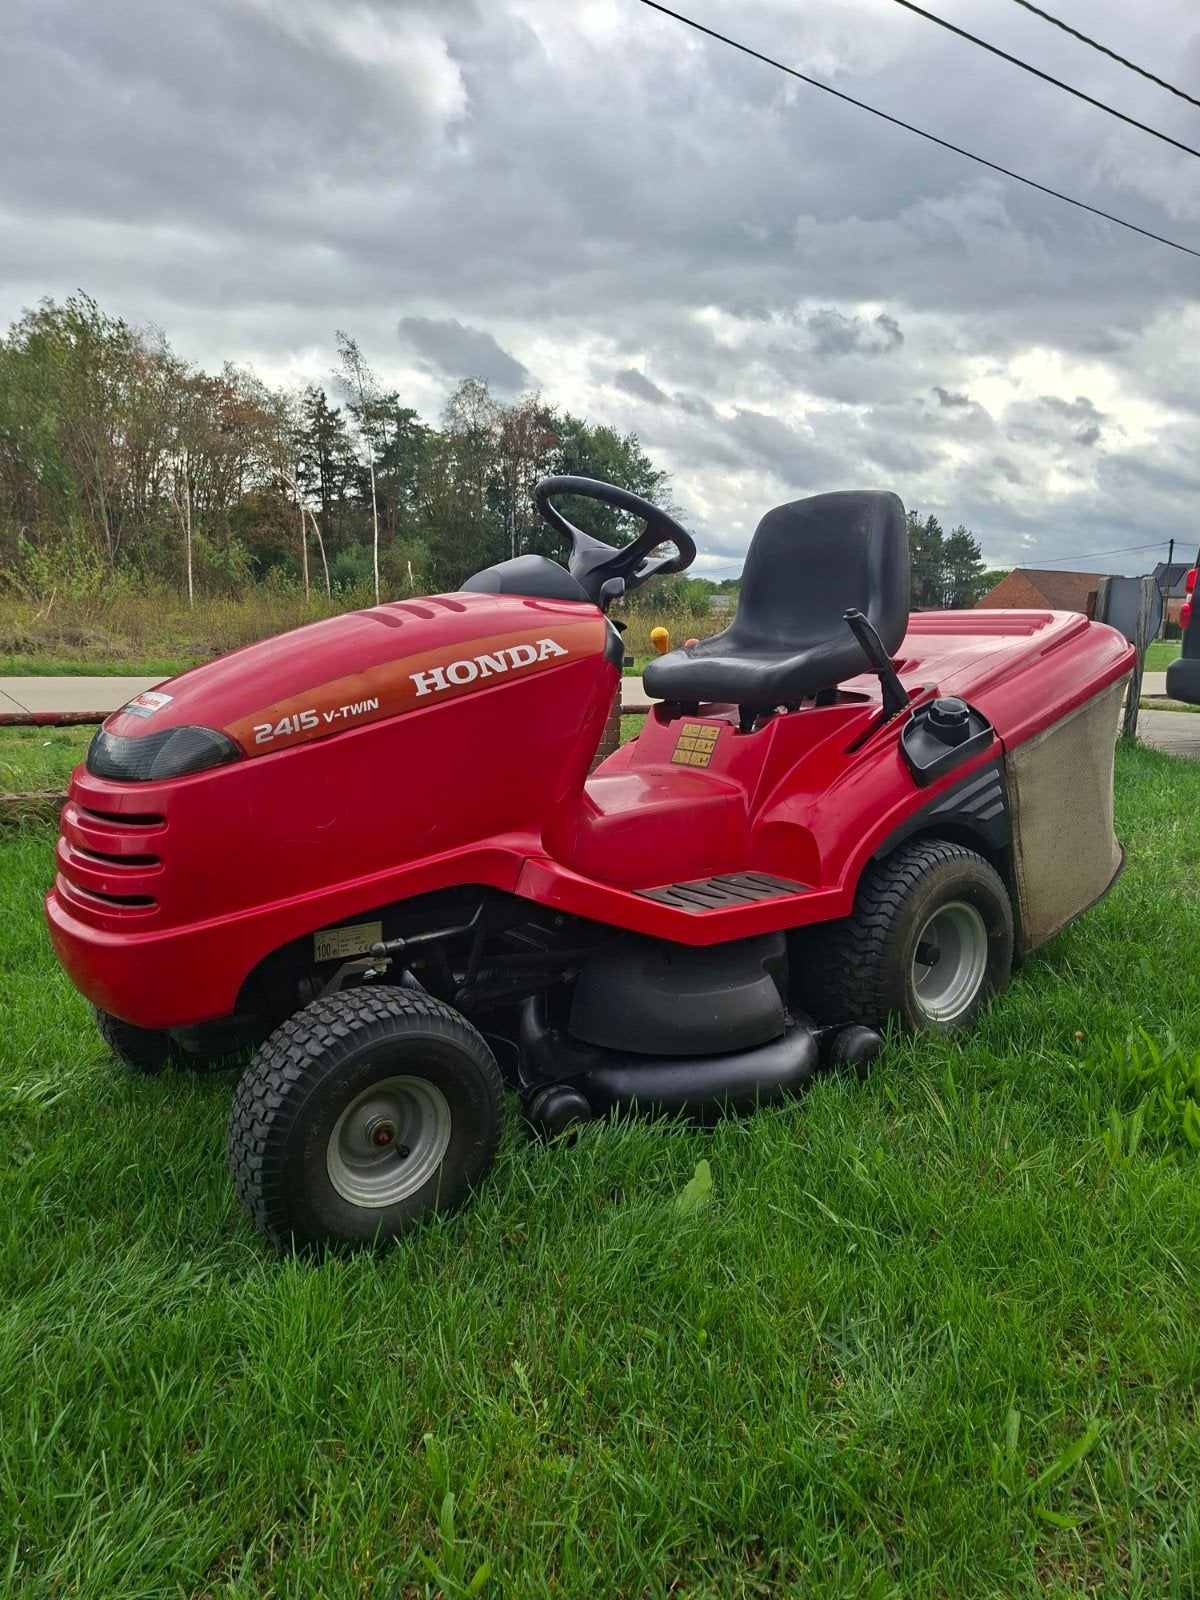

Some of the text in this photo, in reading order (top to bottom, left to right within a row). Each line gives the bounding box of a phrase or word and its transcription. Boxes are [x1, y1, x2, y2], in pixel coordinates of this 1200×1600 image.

[409, 638, 569, 696] HONDA
[253, 697, 379, 744] 2415 V-TWIN
[317, 943, 331, 958] 100
